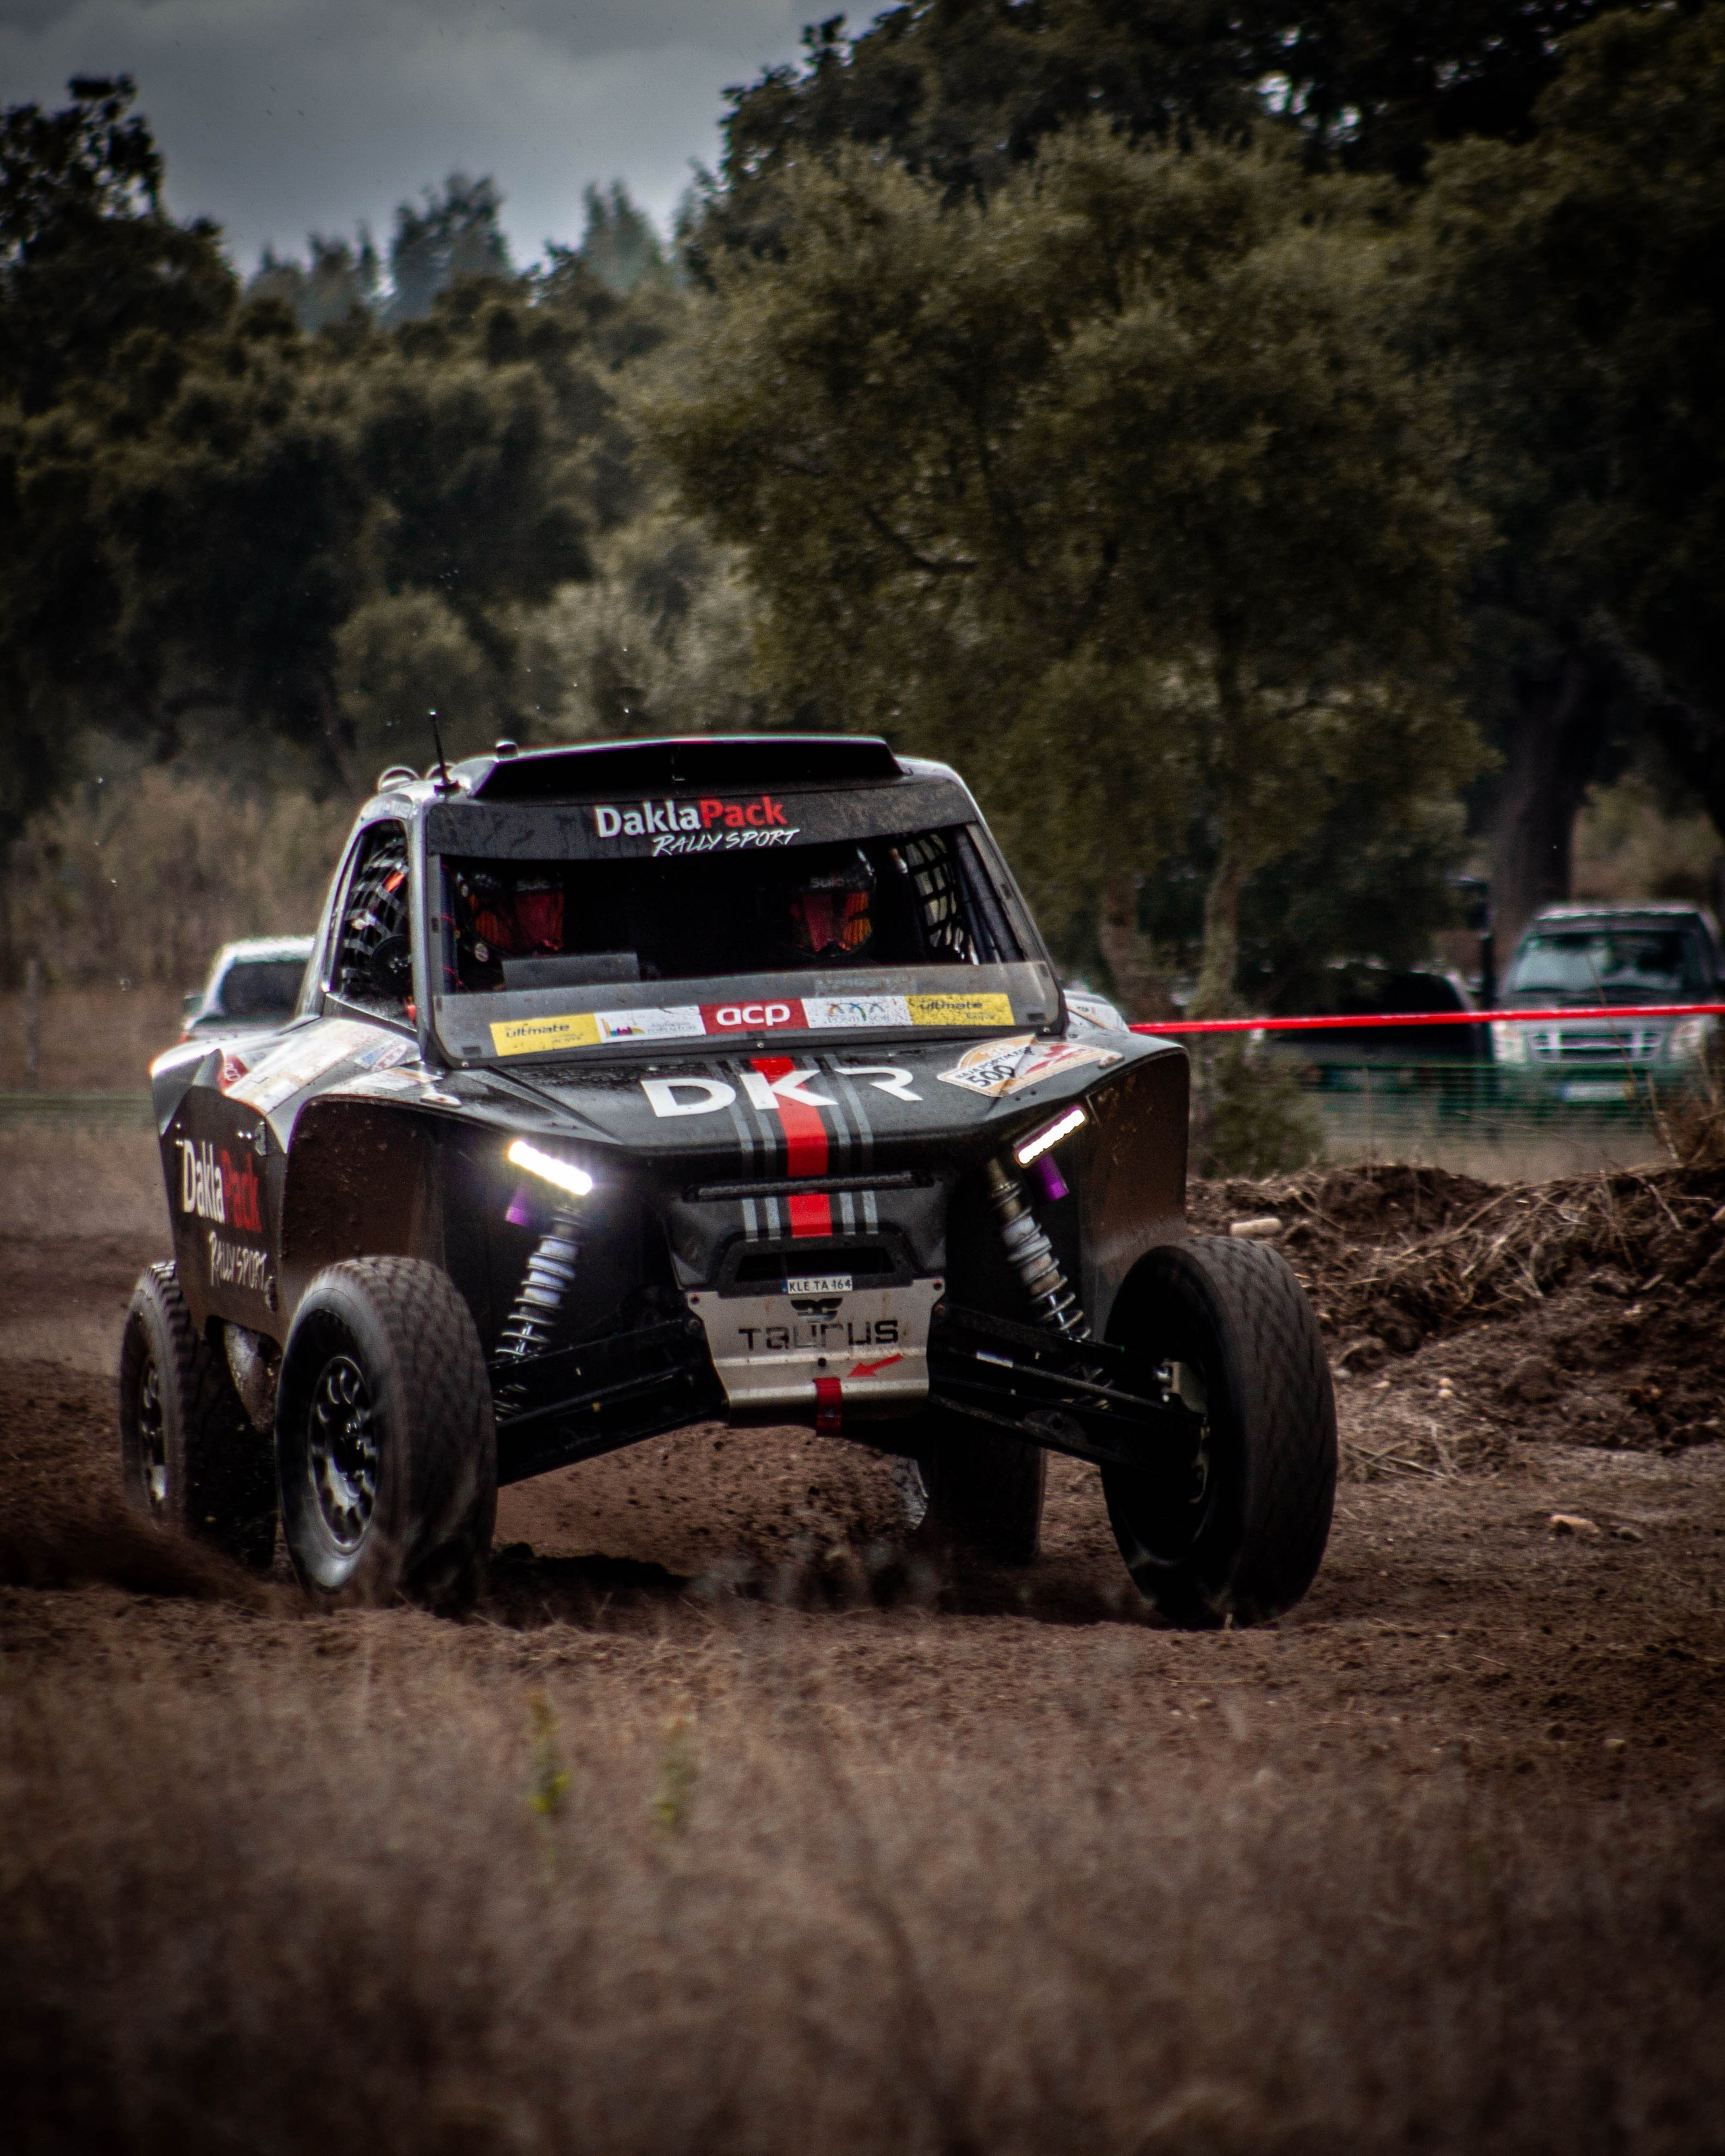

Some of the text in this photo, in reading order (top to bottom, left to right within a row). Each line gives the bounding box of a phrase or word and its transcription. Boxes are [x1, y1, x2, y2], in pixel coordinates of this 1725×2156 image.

[594, 796, 787, 837] DaklaPack
[716, 1004, 790, 1026] acp
[966, 1065, 1015, 1087] 500
[641, 1067, 923, 1118] DKR
[789, 1279, 850, 1292] KLE TA 164
